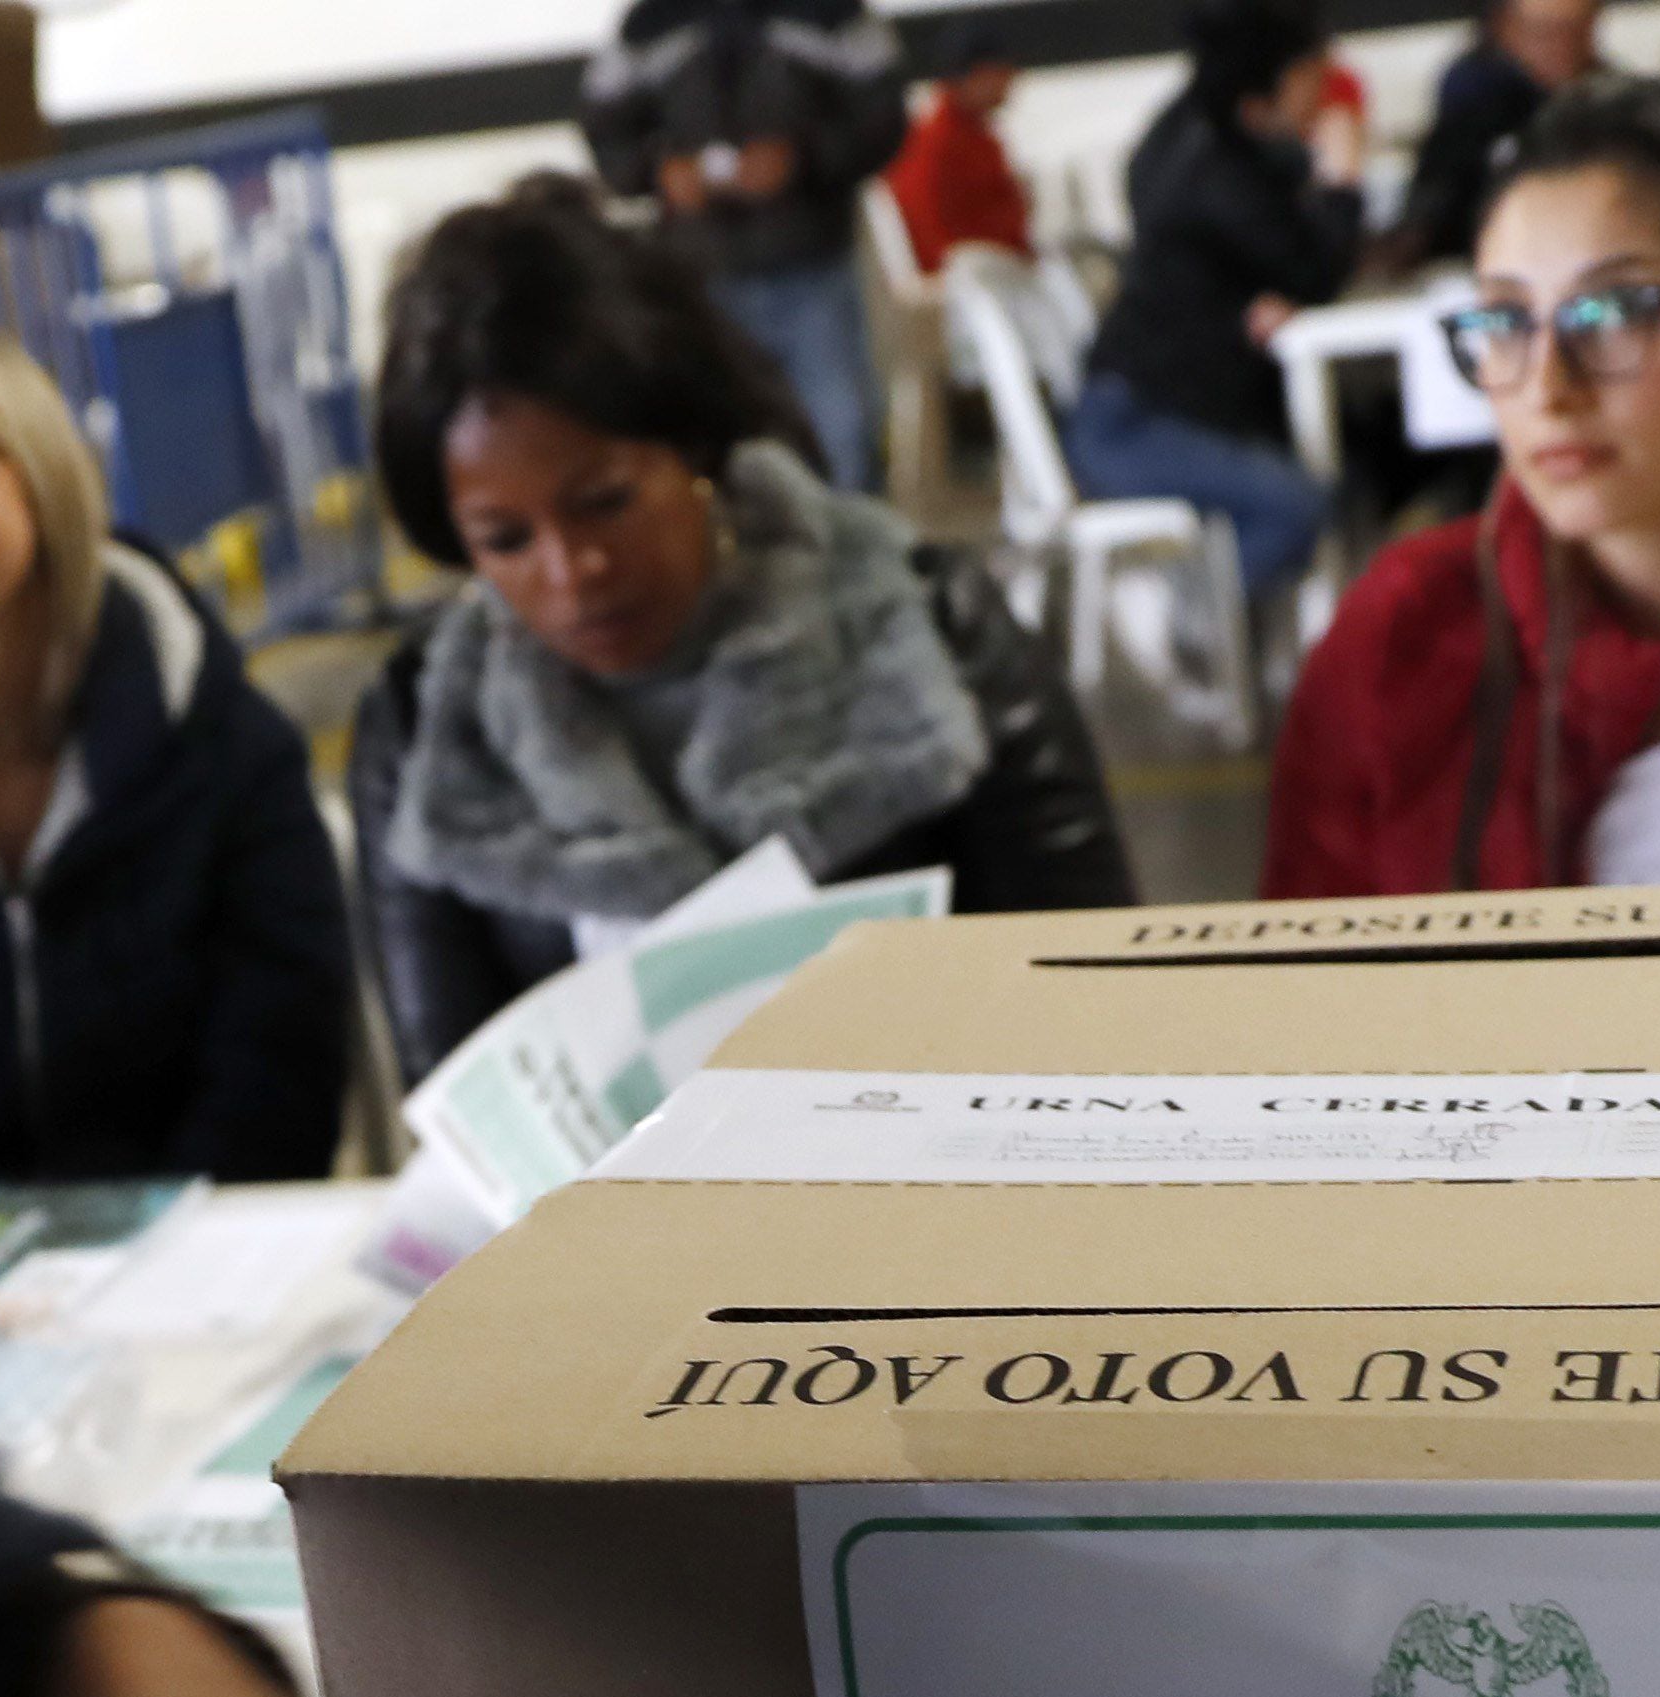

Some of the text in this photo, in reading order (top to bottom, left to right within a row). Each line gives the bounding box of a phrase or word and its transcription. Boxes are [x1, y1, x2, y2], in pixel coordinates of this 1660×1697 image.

[1129, 904, 1543, 944] DEPOSITE
[967, 1096, 1186, 1112] URNA
[645, 1345, 963, 1418] AQUÍ
[983, 1350, 1308, 1405] VOTO
[1338, 1348, 1508, 1403] SU
